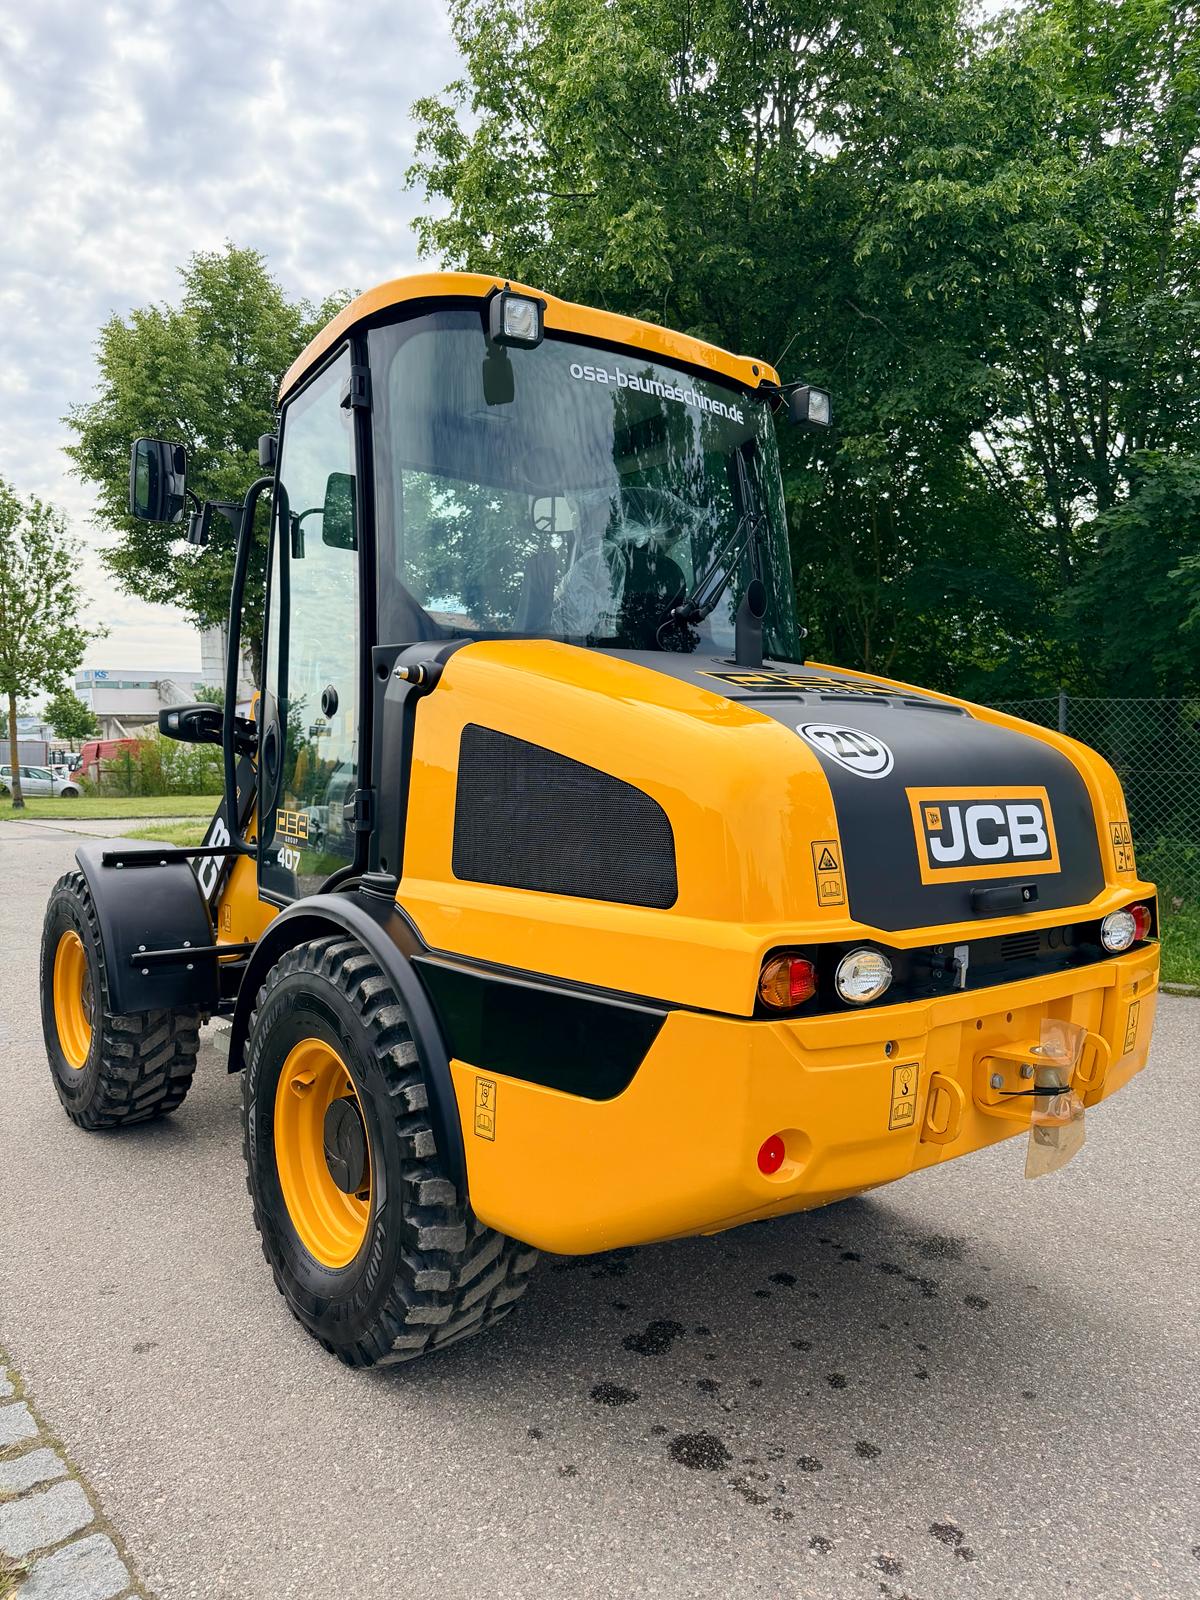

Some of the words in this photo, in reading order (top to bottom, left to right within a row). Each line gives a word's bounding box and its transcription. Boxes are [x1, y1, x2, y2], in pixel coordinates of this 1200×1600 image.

[569, 363, 745, 426] osa-baumaschinen.de
[813, 730, 880, 758] 20
[929, 804, 1048, 863] JCB
[277, 847, 301, 872] 407
